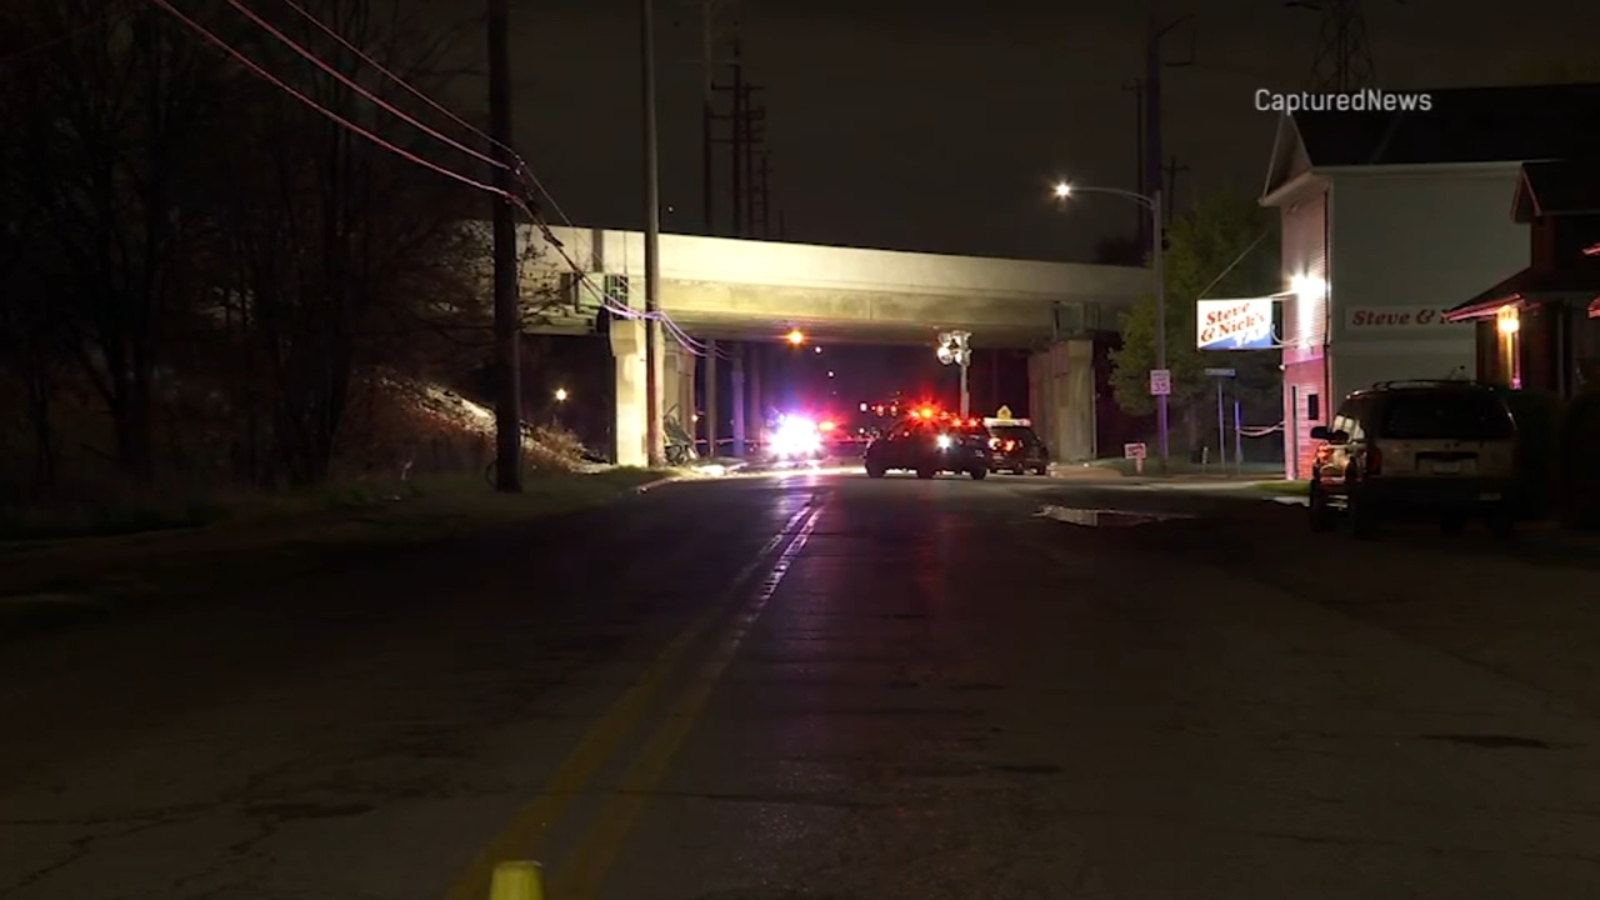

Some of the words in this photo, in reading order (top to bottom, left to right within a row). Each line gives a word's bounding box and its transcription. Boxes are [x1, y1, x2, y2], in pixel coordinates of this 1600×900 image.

[1205, 302, 1250, 326] Steve
[1352, 310, 1410, 326] Steve
[1416, 309, 1435, 325] &
[1200, 327, 1215, 343] &
